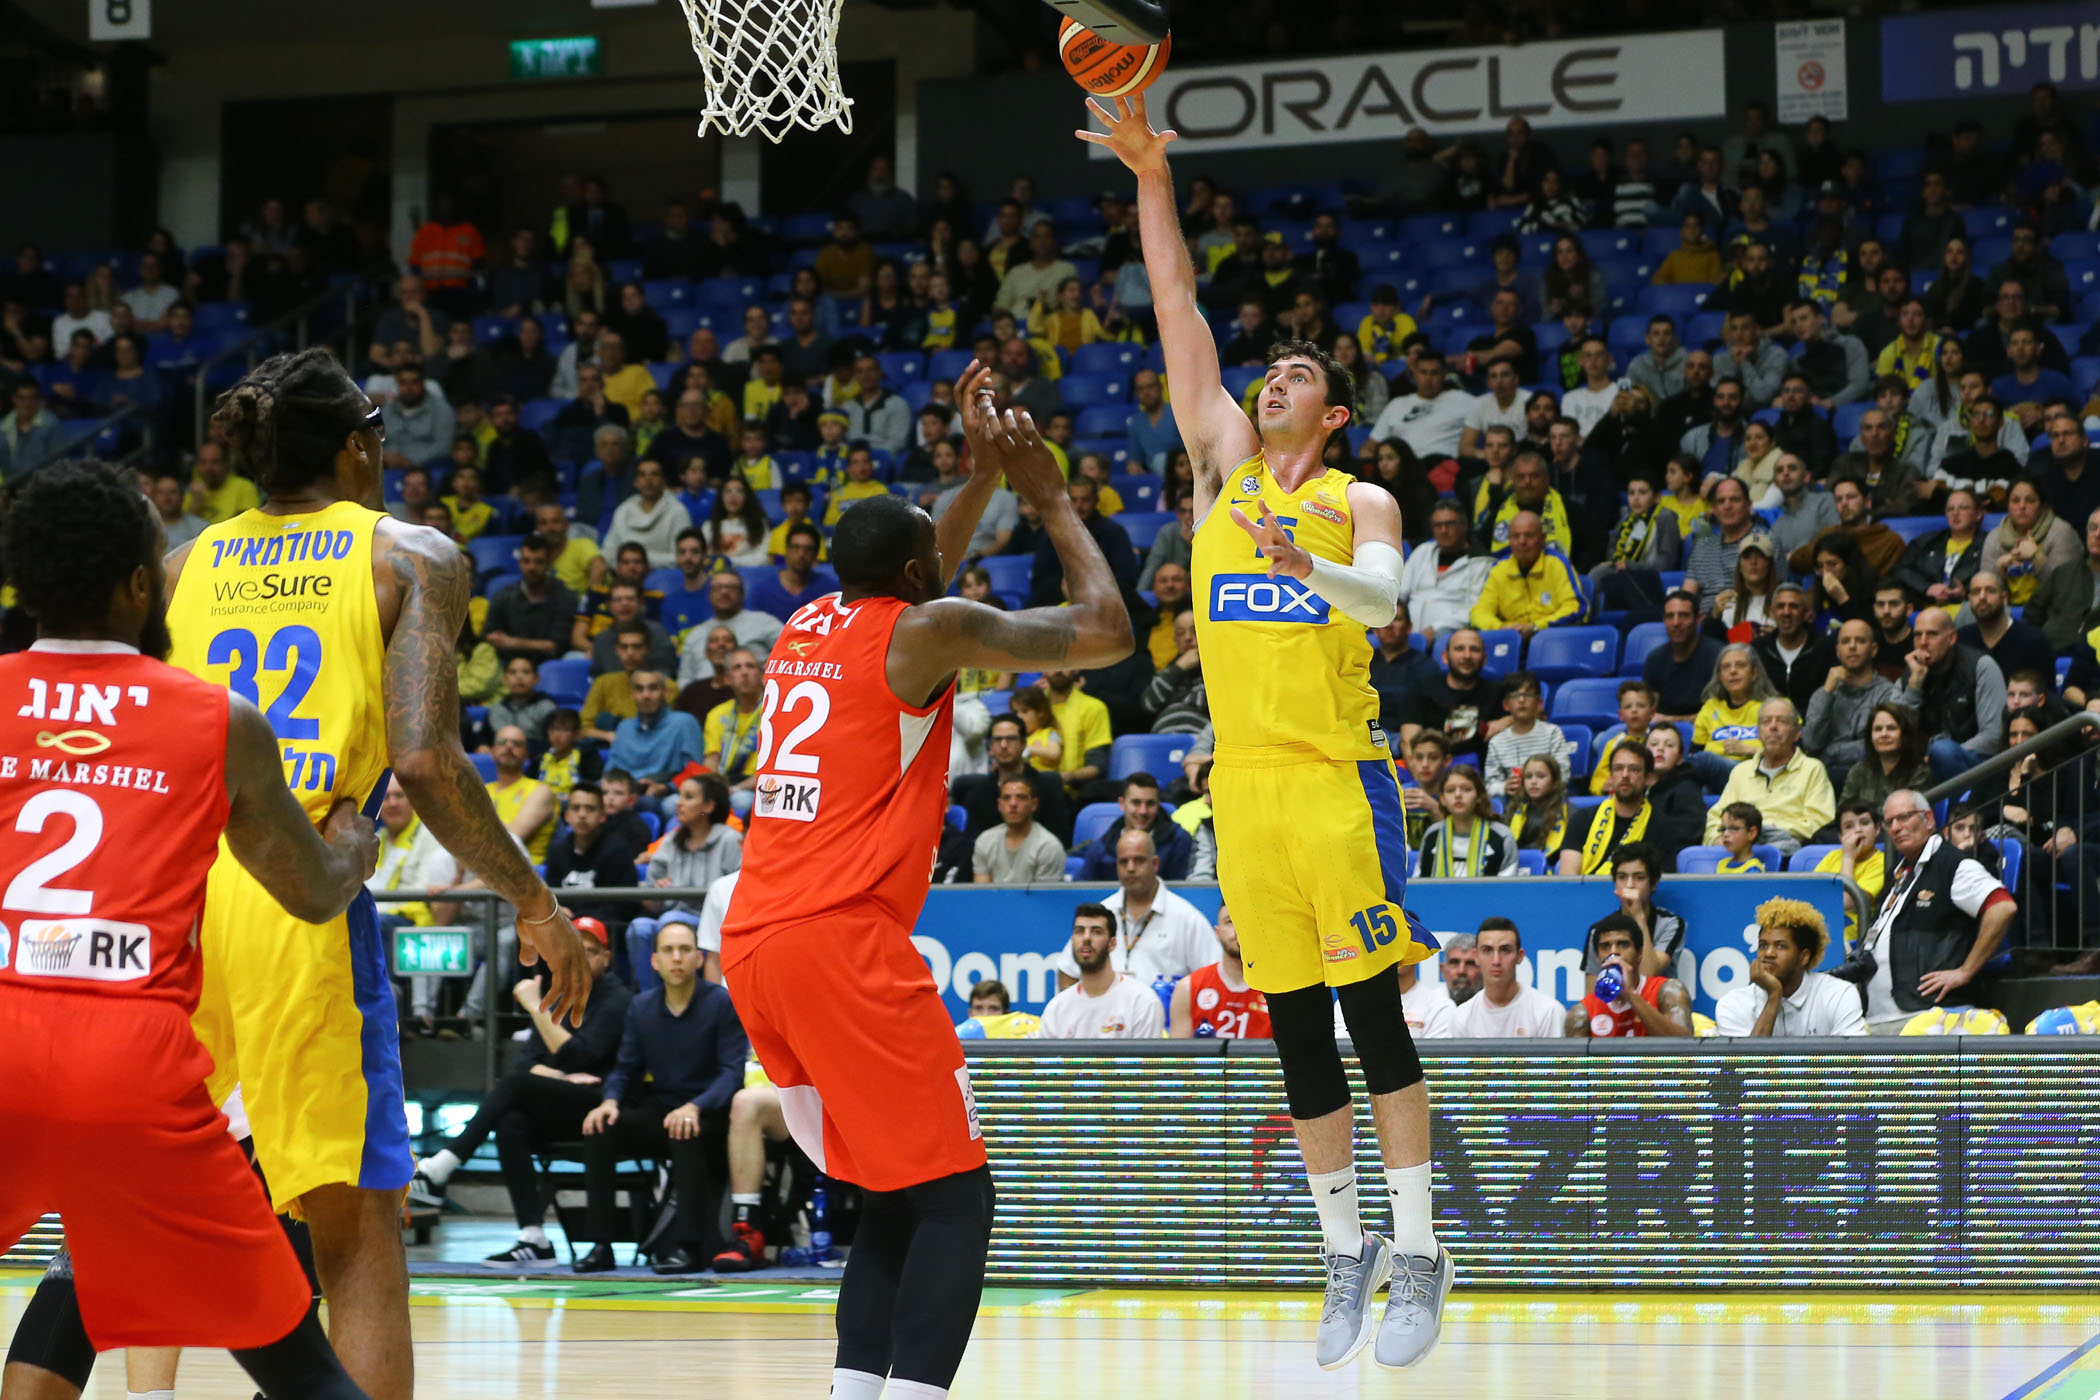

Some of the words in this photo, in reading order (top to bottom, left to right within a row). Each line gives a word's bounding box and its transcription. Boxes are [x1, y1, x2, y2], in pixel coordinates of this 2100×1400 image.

[1083, 52, 1136, 90] molten
[1164, 46, 1625, 141] ORACLE
[211, 529, 354, 569] סטודמאייר
[210, 604, 268, 617] Insurance
[269, 600, 330, 614] Company
[1216, 581, 1320, 616] FOX
[206, 624, 323, 741] 32
[776, 660, 844, 681] MARSHEL
[17, 677, 150, 727] יאנג
[755, 678, 832, 775] 32
[28, 758, 170, 795] MARSHEL
[781, 783, 818, 814] RK
[2, 788, 104, 915] 2
[1349, 903, 1398, 954] 15
[88, 930, 147, 971] RK
[1215, 1009, 1250, 1039] 21
